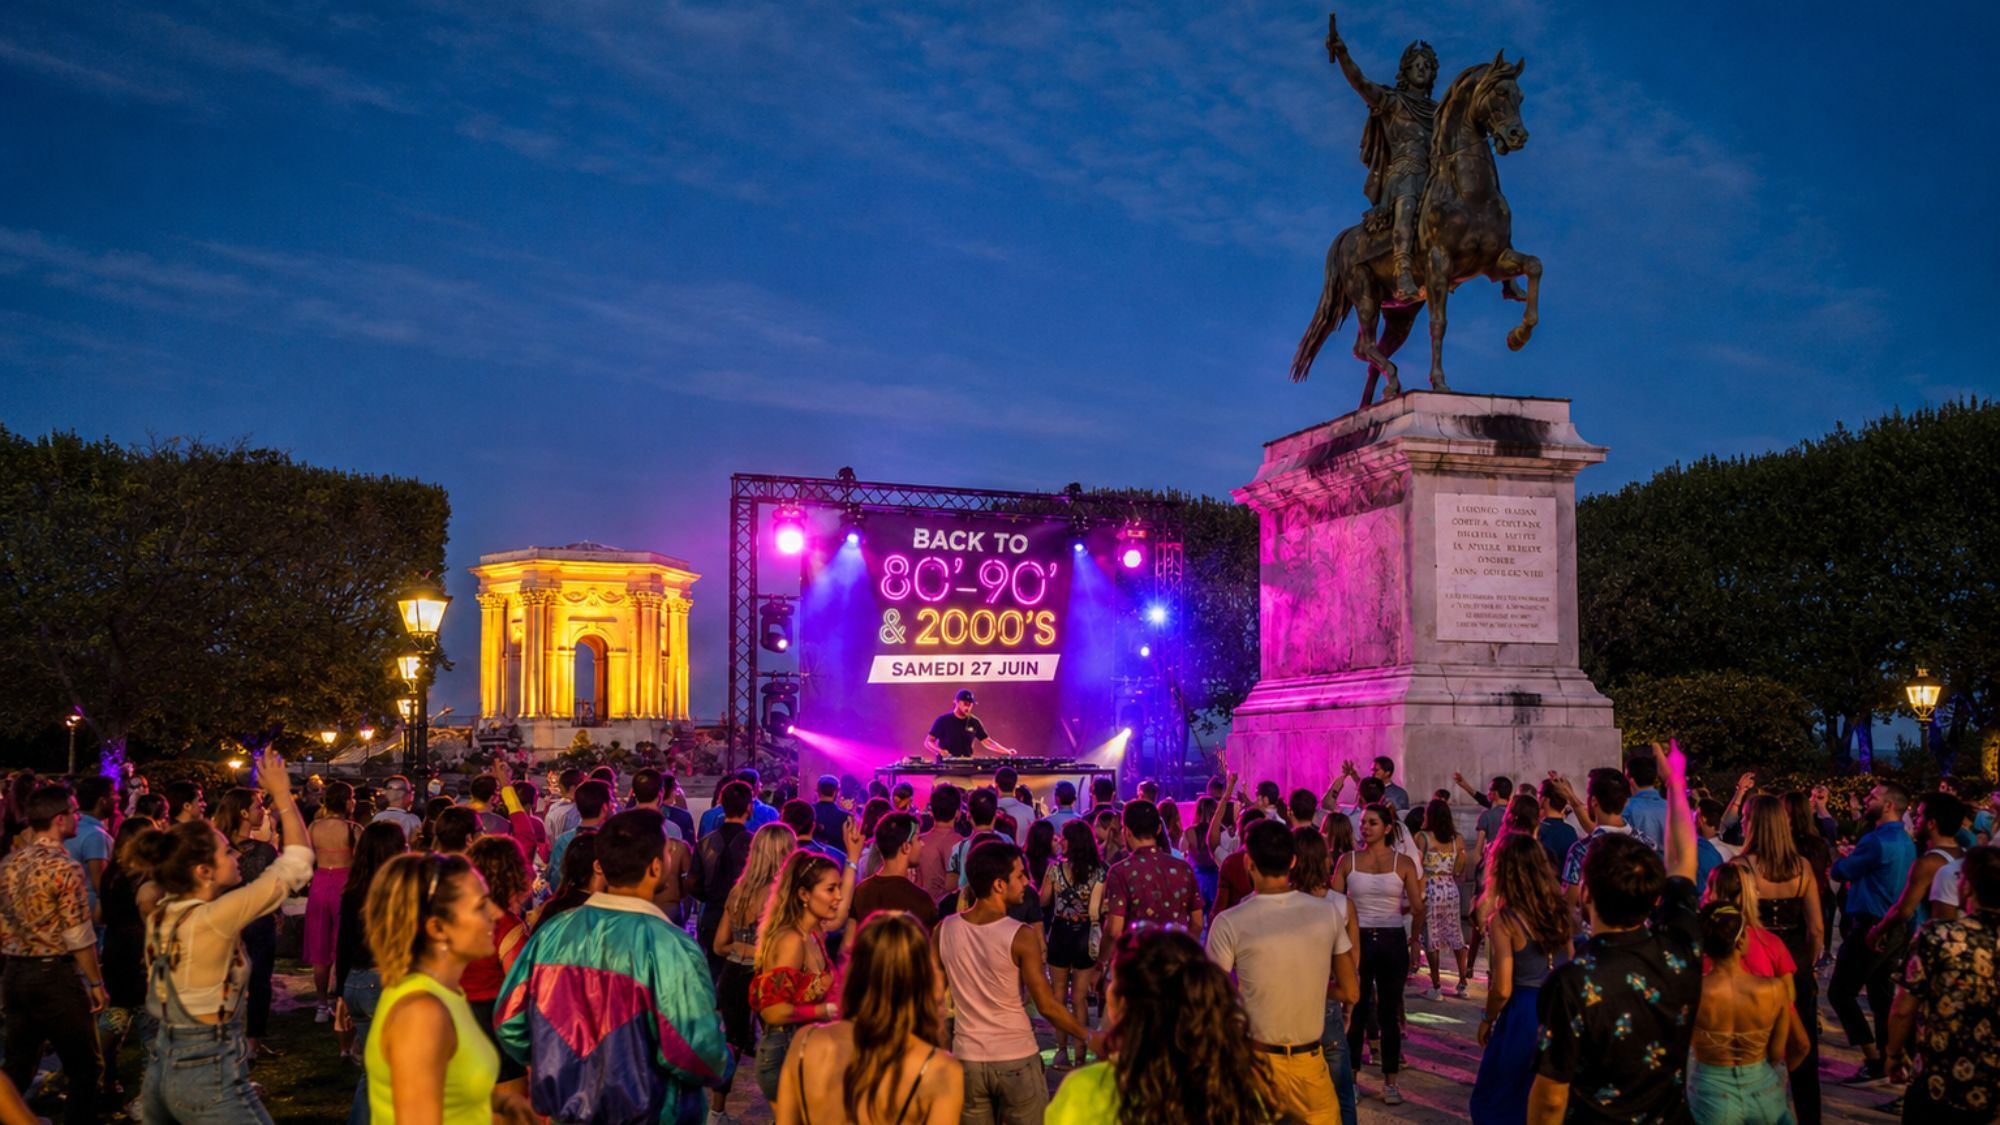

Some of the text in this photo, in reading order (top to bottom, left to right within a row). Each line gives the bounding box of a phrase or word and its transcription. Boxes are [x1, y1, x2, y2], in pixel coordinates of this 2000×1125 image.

[913, 528, 1028, 554] BACK TO
[879, 608, 1056, 645] & 2000'S
[892, 661, 1039, 677] SAMEDI 27 JUIN
